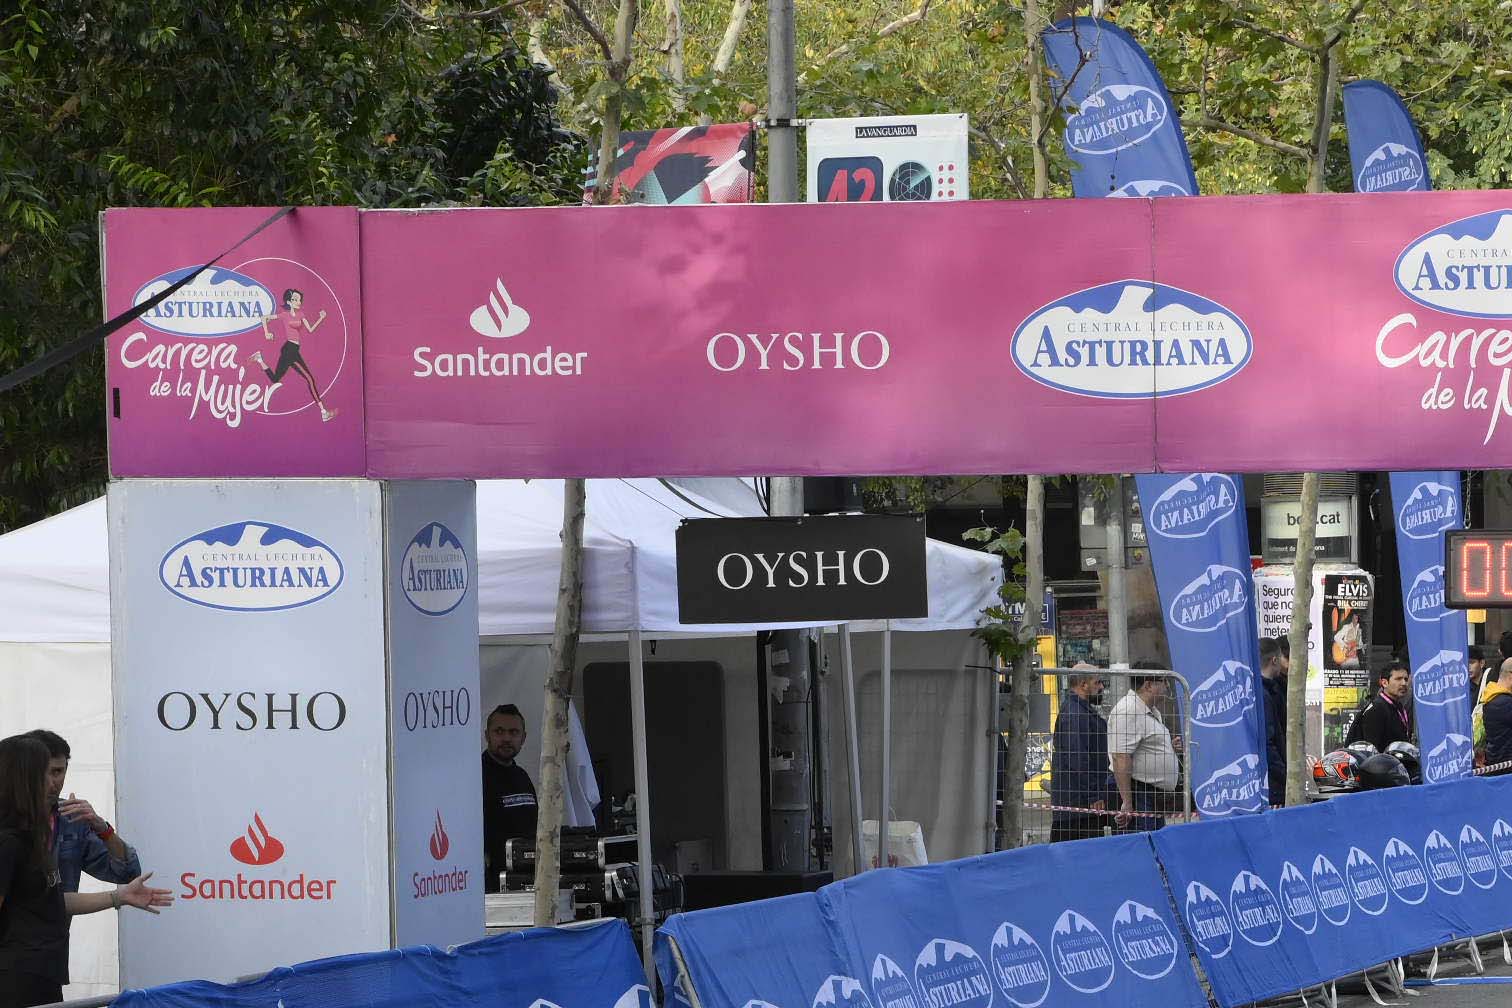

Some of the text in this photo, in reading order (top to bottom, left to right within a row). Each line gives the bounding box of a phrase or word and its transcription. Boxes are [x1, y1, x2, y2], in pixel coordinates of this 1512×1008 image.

[144, 288, 265, 318] ASTURIANA
[169, 290, 209, 298] ENTRAL
[1067, 320, 1226, 334] CENTRAL LECHERA
[120, 332, 238, 370] Carrera
[412, 345, 588, 377] Santander
[705, 330, 890, 372] OYSHO
[1030, 325, 1234, 368] ASTURIANA
[150, 366, 283, 428] de la Mujer
[1421, 372, 1455, 410] de
[1463, 369, 1488, 410] la
[1287, 511, 1341, 526] b.cat
[174, 554, 331, 588] ASTURIANA
[202, 552, 324, 561] CENTRAL LECHERA
[716, 548, 891, 590] OYSHO
[406, 556, 465, 593] ASTURIANA
[1337, 583, 1368, 597] ELVIS
[1263, 600, 1279, 613] que
[1263, 611, 1292, 627] quiere
[157, 691, 347, 732] OYSHO
[404, 686, 470, 732] OYSHO
[180, 872, 337, 901] Santander
[413, 865, 468, 900] Santander
[1057, 944, 1112, 976] ASTURIANA
[1119, 933, 1174, 962] ASTURIANA
[996, 958, 1047, 989] ASTURIANA
